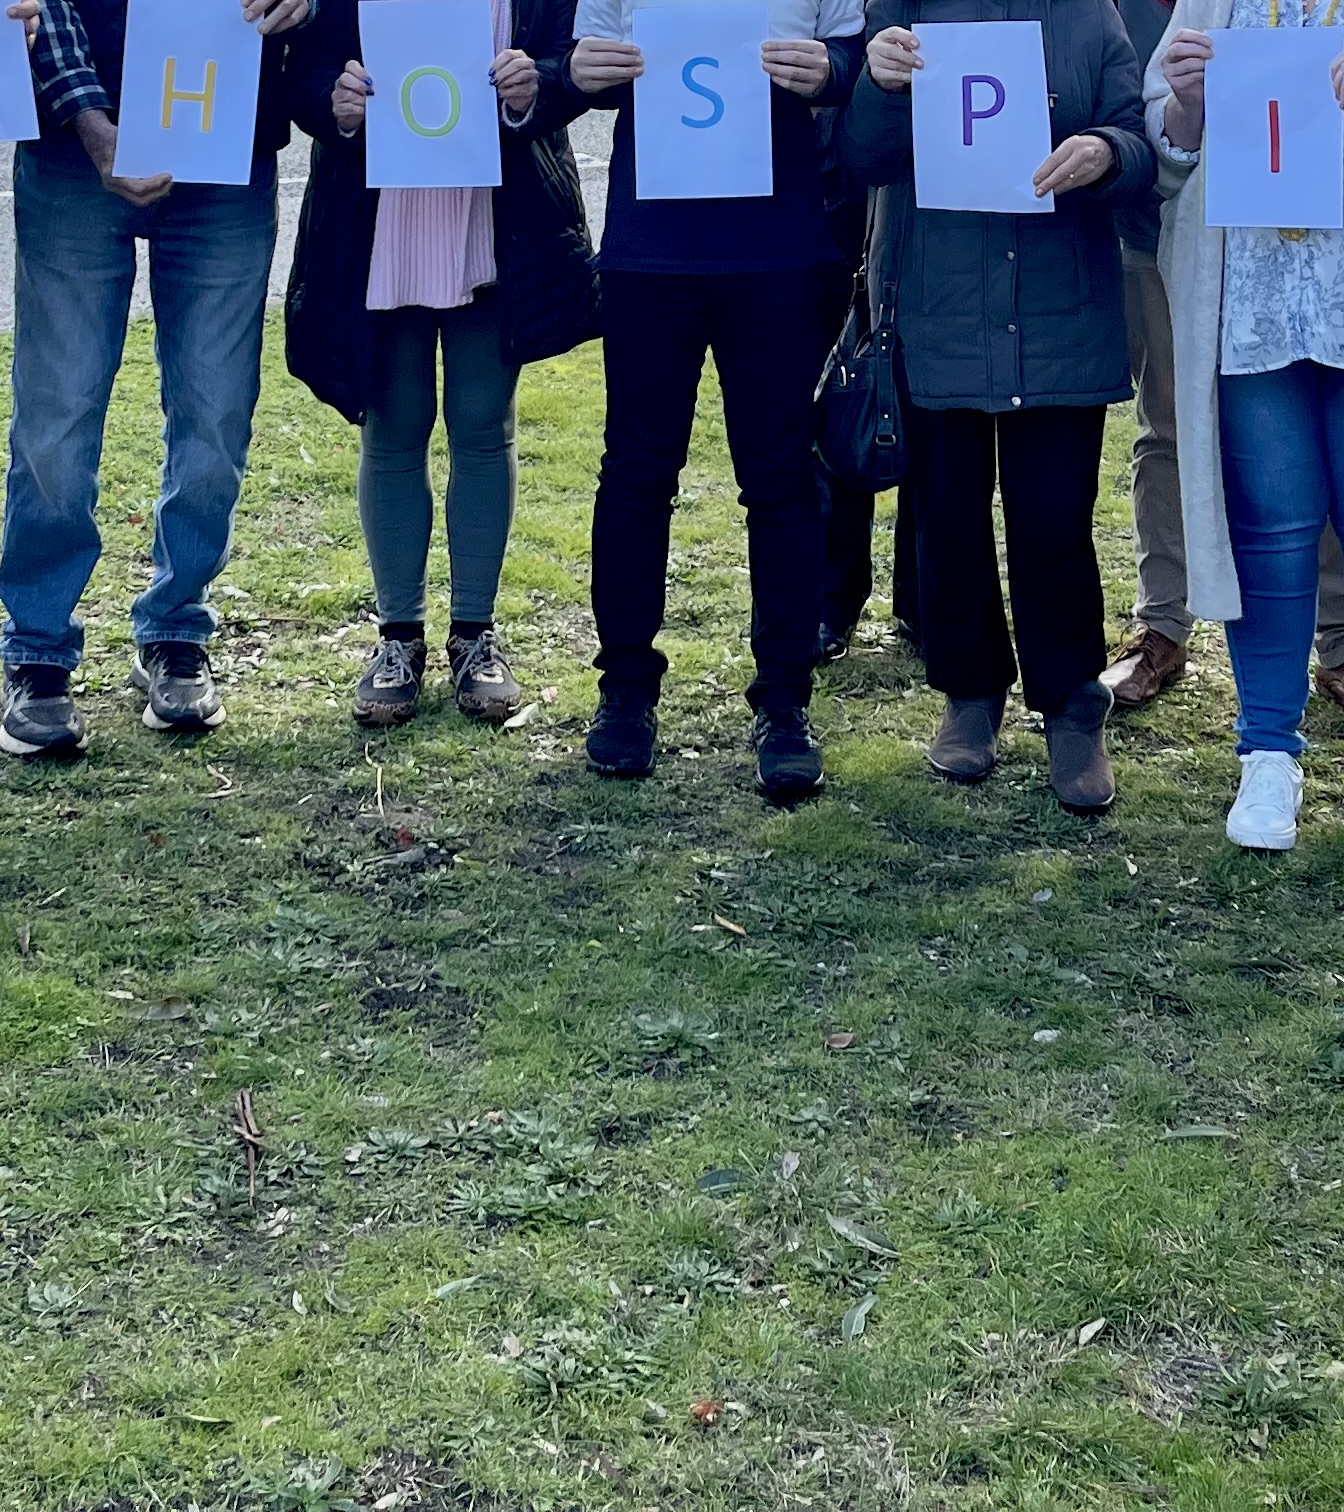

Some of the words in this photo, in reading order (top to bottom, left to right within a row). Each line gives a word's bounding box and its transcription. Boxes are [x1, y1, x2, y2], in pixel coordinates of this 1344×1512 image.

[160, 57, 217, 133] H
[399, 66, 462, 138] O
[681, 56, 726, 129] S
[960, 74, 1006, 146] P
[1268, 100, 1281, 174] I
